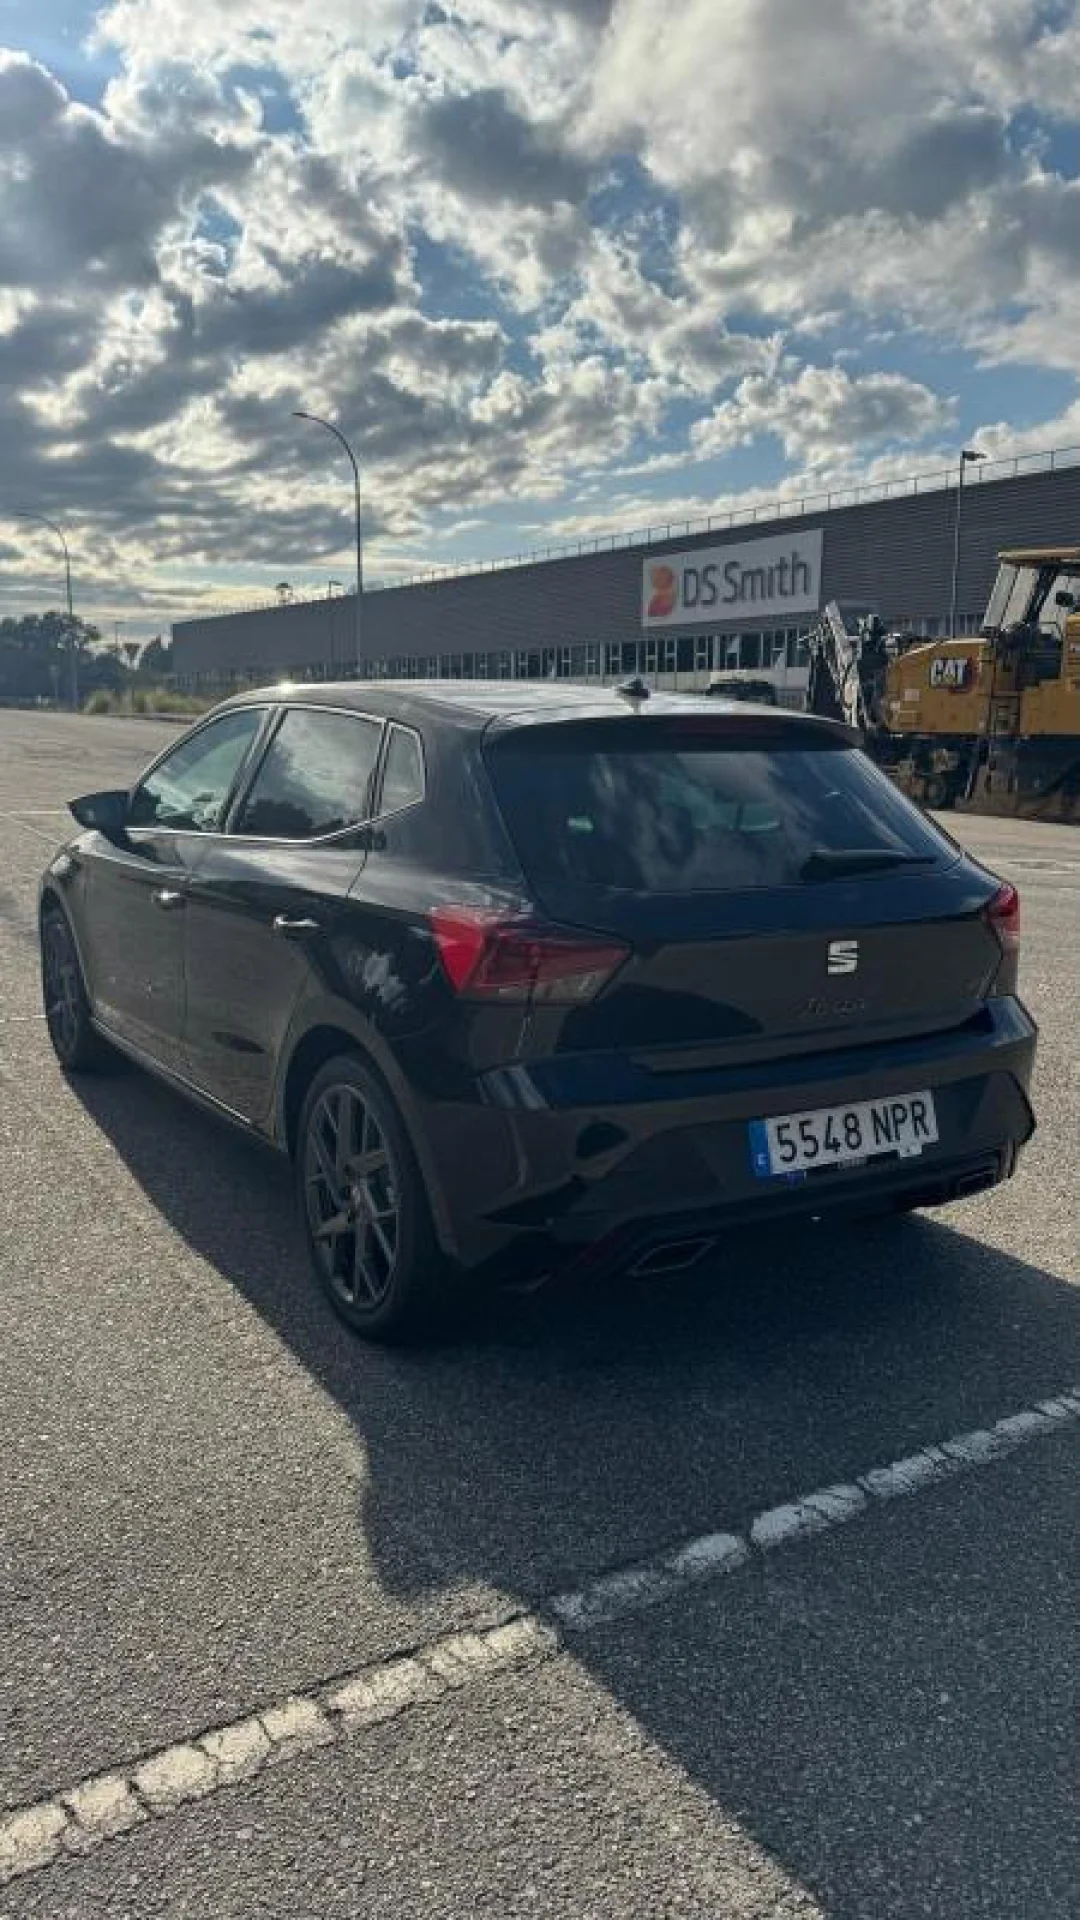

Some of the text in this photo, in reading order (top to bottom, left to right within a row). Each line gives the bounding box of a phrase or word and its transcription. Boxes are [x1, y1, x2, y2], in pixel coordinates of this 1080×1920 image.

[682, 551, 809, 608] DS Smith
[930, 658, 968, 686] CAT
[776, 1101, 929, 1163] 5548 NPR
